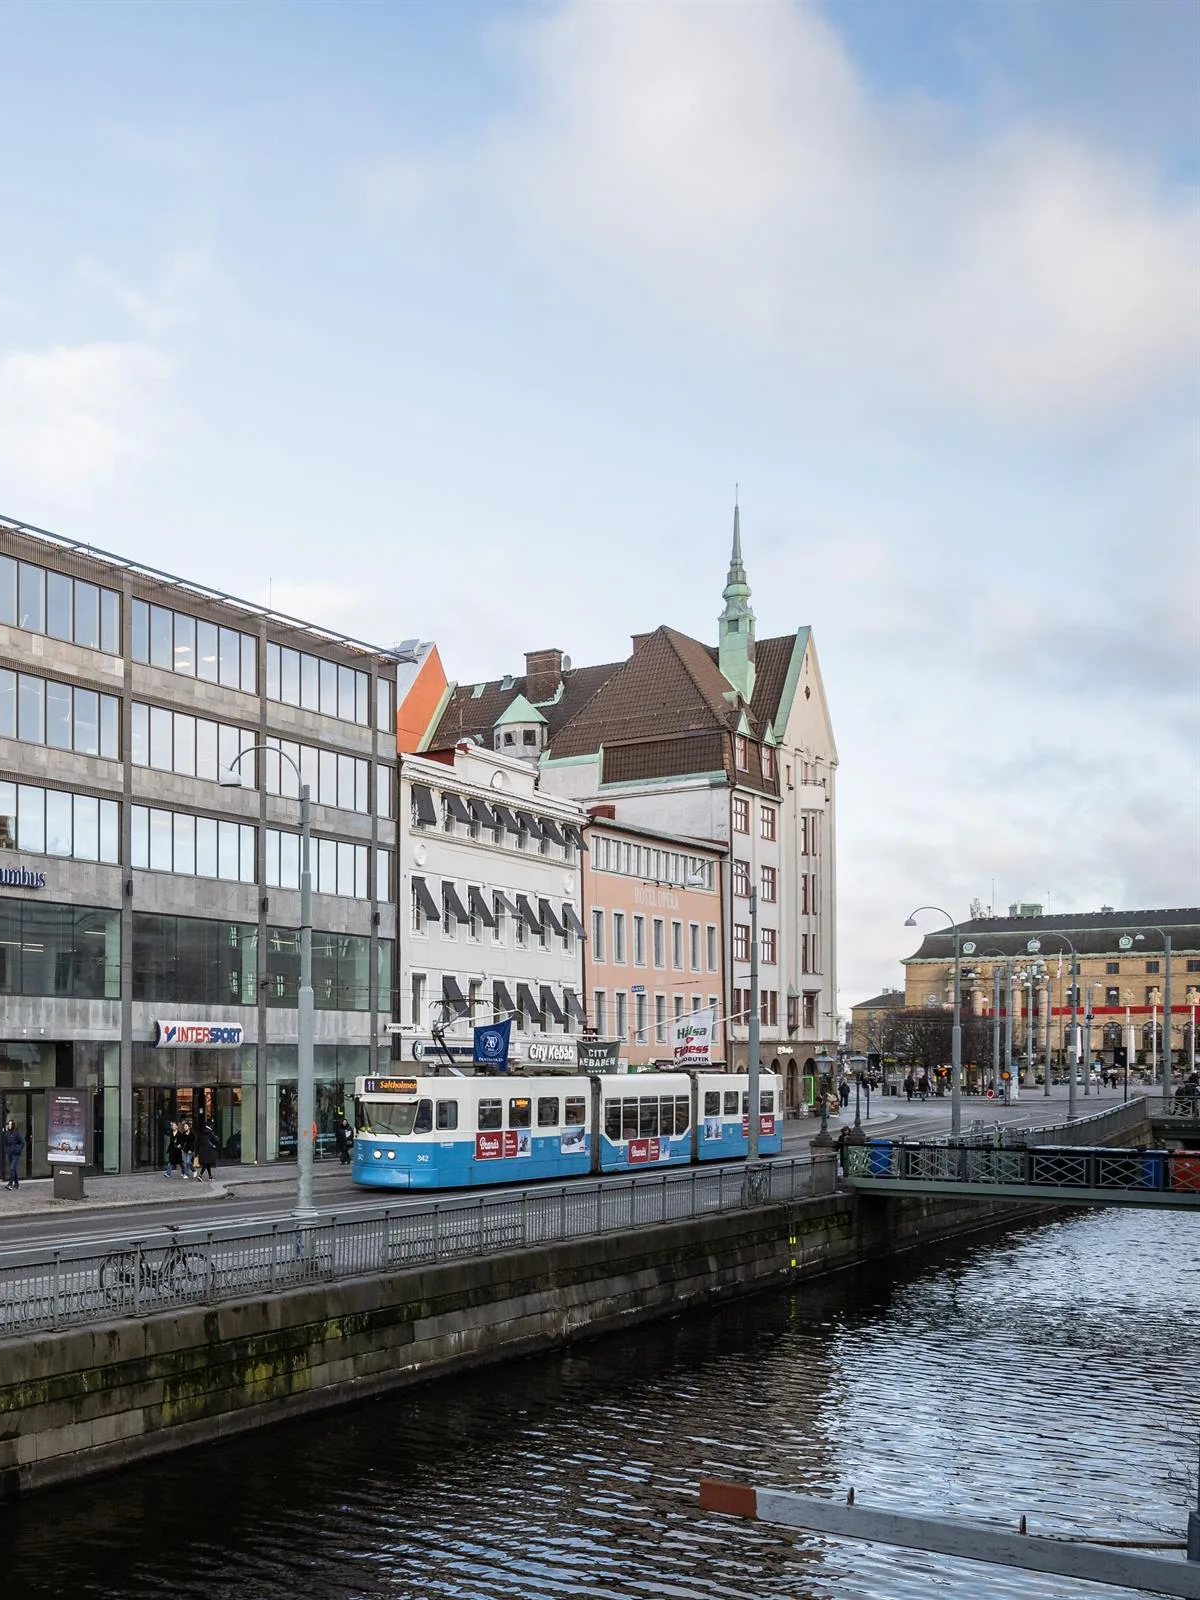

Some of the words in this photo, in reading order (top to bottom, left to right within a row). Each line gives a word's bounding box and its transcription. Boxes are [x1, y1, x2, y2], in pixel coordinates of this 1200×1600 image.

[176, 1026, 242, 1043] INTERSPORT
[529, 1043, 547, 1061] City
[548, 1045, 574, 1060] Kebab
[588, 1049, 608, 1057] CITY
[417, 1154, 429, 1162] 342
